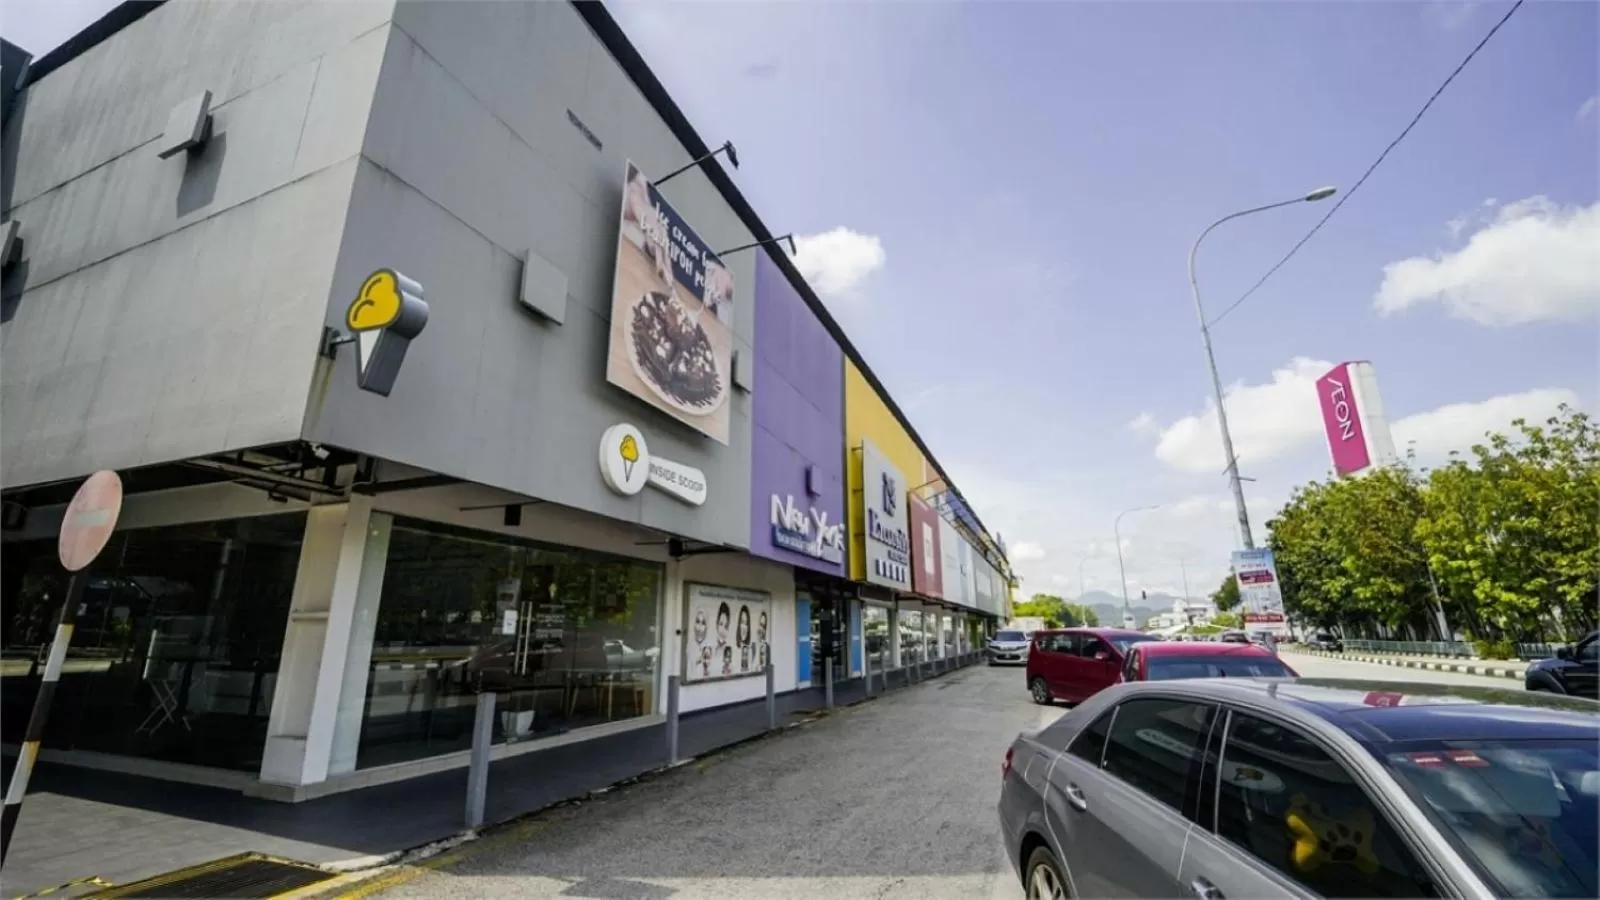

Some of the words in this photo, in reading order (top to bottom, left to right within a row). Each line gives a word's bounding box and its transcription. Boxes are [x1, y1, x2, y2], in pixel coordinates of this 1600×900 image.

[672, 226, 700, 261] cream
[648, 462, 677, 484] INSIDE
[678, 474, 704, 492] SCOOP
[771, 493, 810, 535] New
